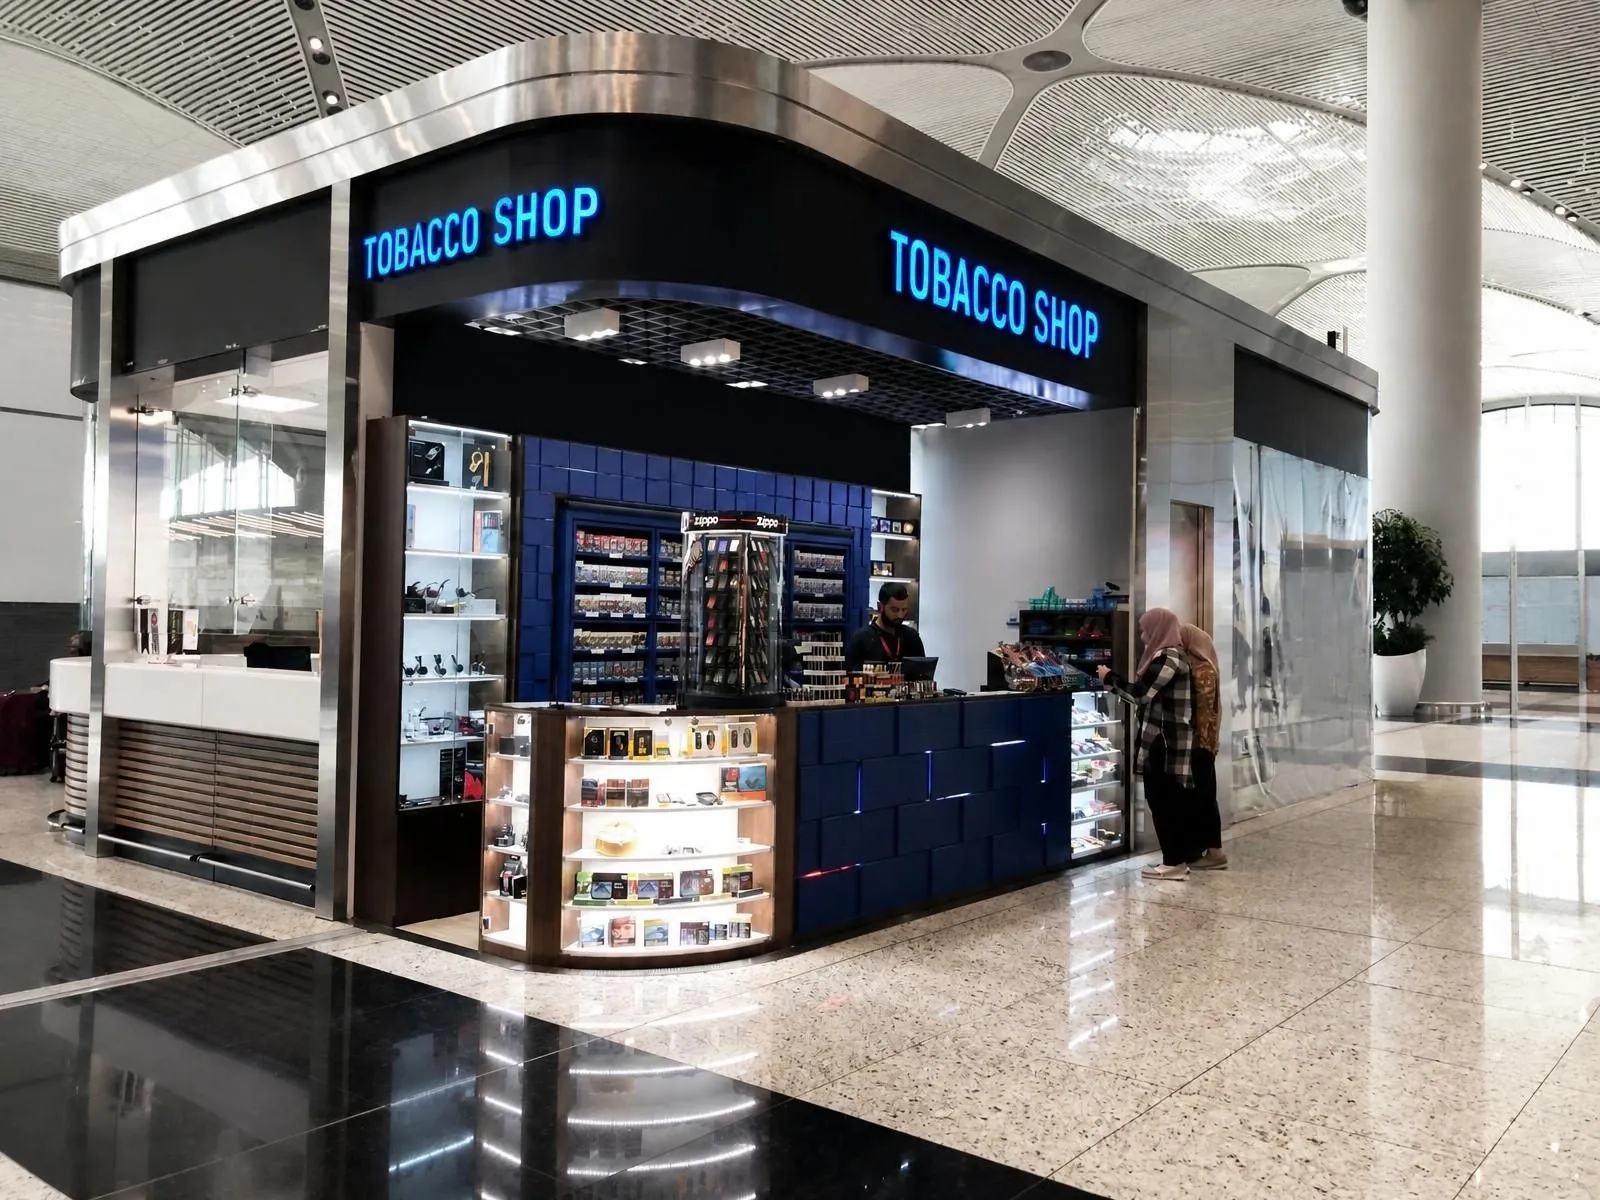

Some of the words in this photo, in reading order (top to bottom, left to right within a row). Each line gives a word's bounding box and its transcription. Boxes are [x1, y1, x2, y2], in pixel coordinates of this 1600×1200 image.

[364, 207, 479, 279] TOBACCO
[494, 187, 599, 244] SHOP
[890, 230, 1026, 335] TOBACCO
[1034, 290, 1099, 359] SHOP
